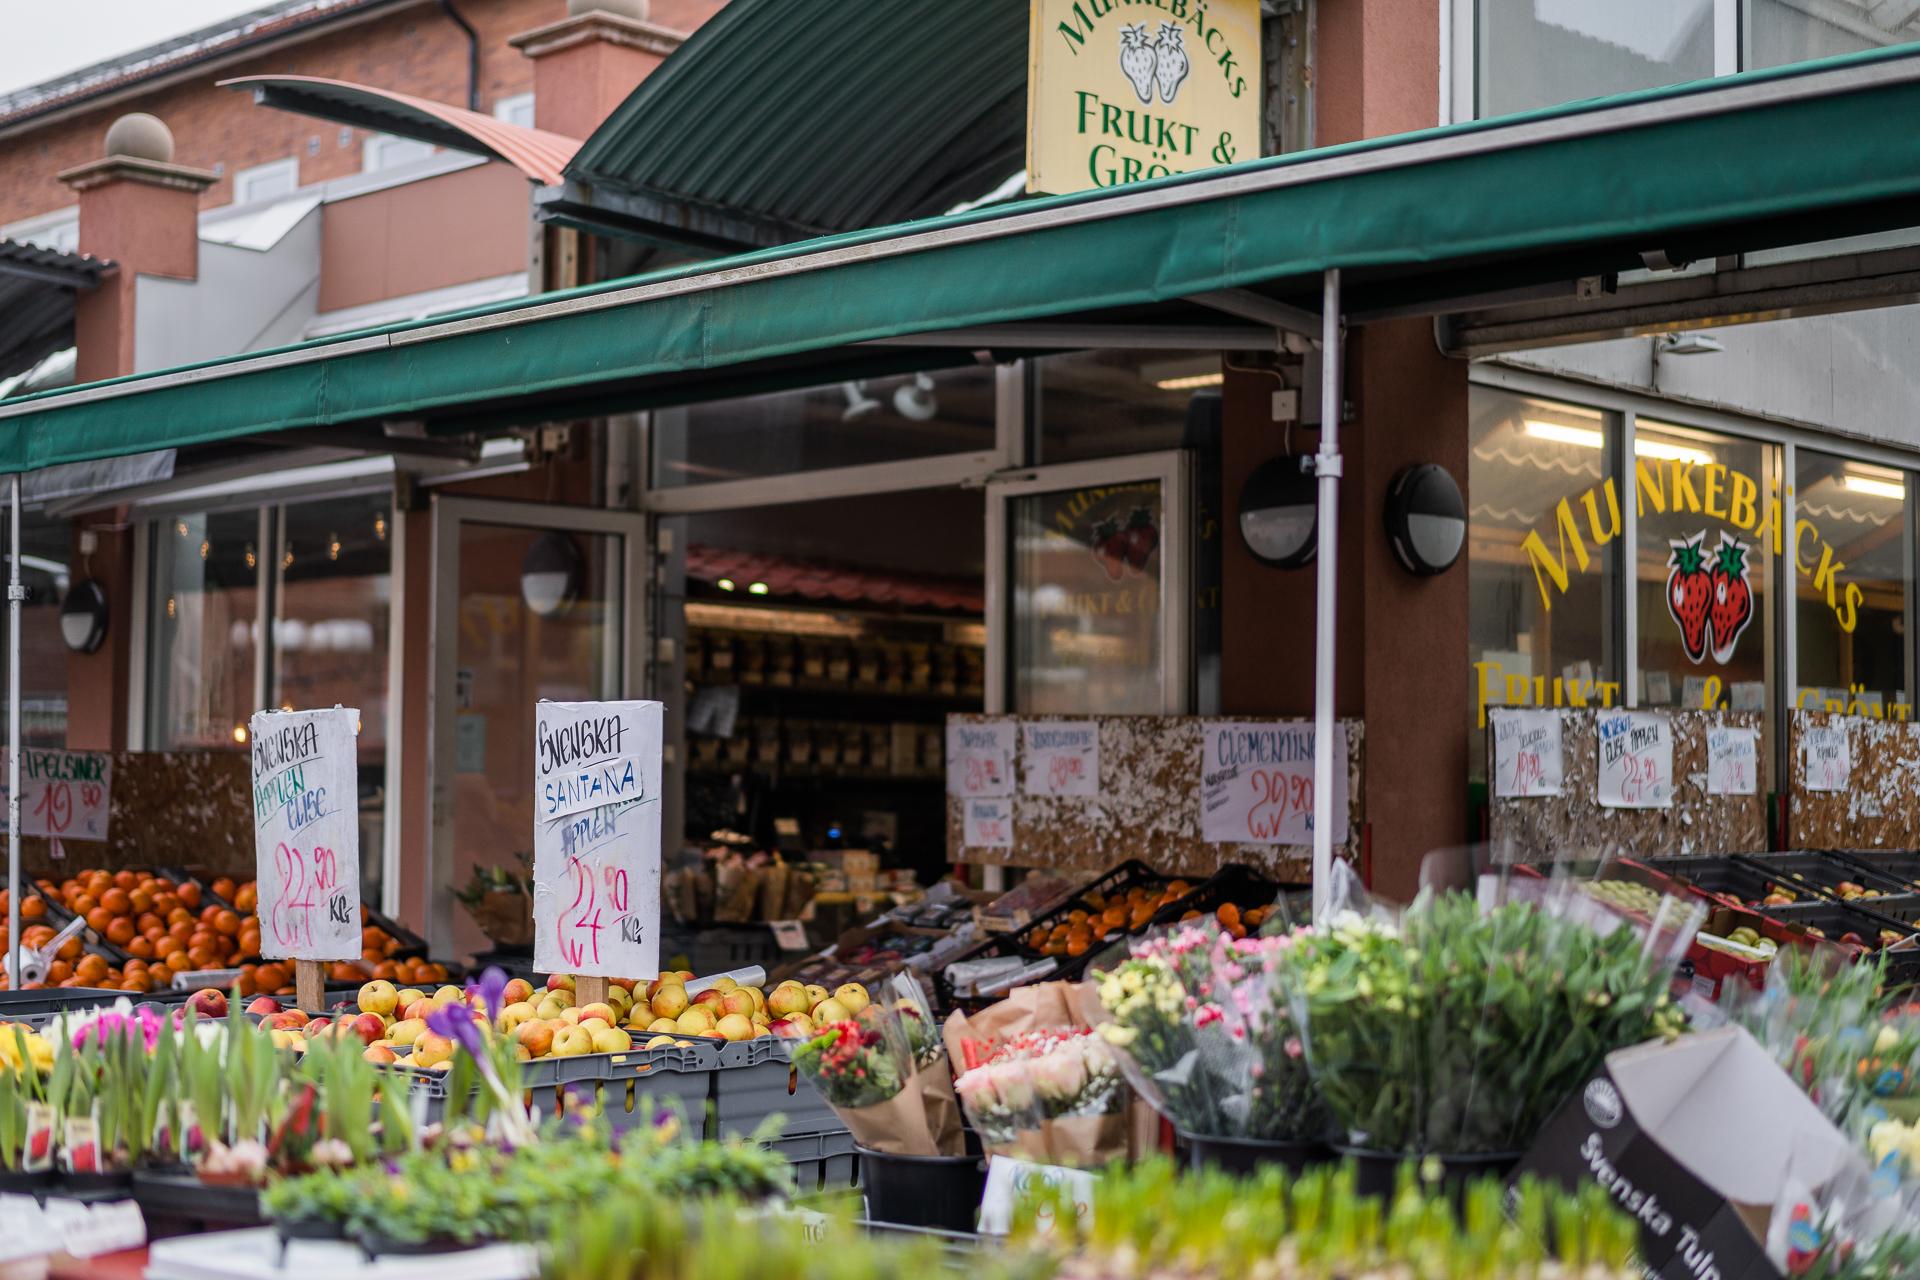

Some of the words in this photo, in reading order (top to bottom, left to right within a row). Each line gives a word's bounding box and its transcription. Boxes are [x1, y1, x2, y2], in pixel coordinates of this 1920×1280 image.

[1074, 90, 1199, 155] FRUKT
[1212, 131, 1236, 164] &
[1520, 458, 1863, 633] MUNKEBÄCKS
[253, 722, 319, 778] SVENSKA
[538, 714, 629, 775] SVENSKA
[286, 787, 327, 831] ELISE
[545, 761, 634, 814] SANTANA
[330, 894, 353, 924] KG
[621, 917, 644, 945] KG
[1581, 1132, 1673, 1236] Svenska
